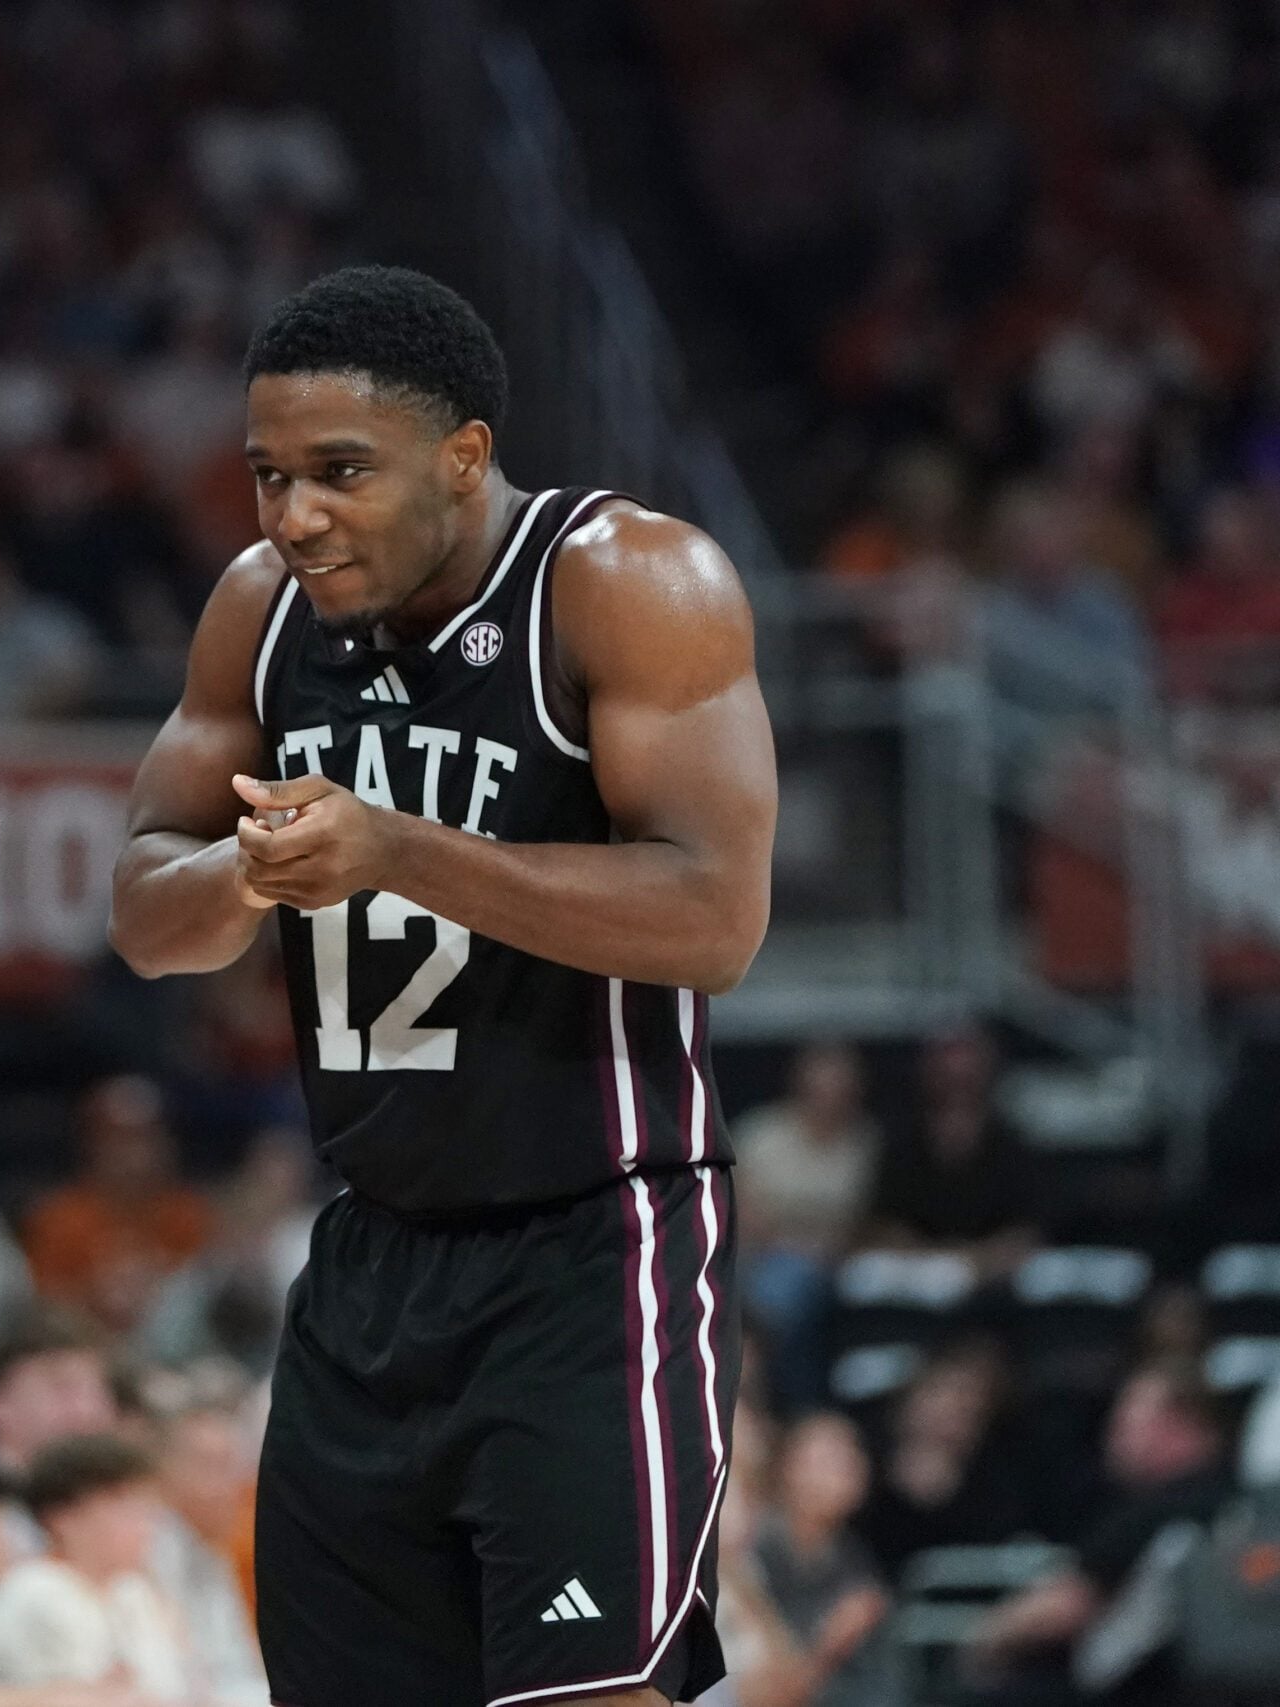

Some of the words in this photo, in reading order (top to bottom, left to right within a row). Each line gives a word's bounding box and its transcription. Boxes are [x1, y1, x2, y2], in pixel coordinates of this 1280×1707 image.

[464, 625, 500, 662] SEC
[277, 724, 517, 840] TATE
[299, 890, 470, 1071] 12
